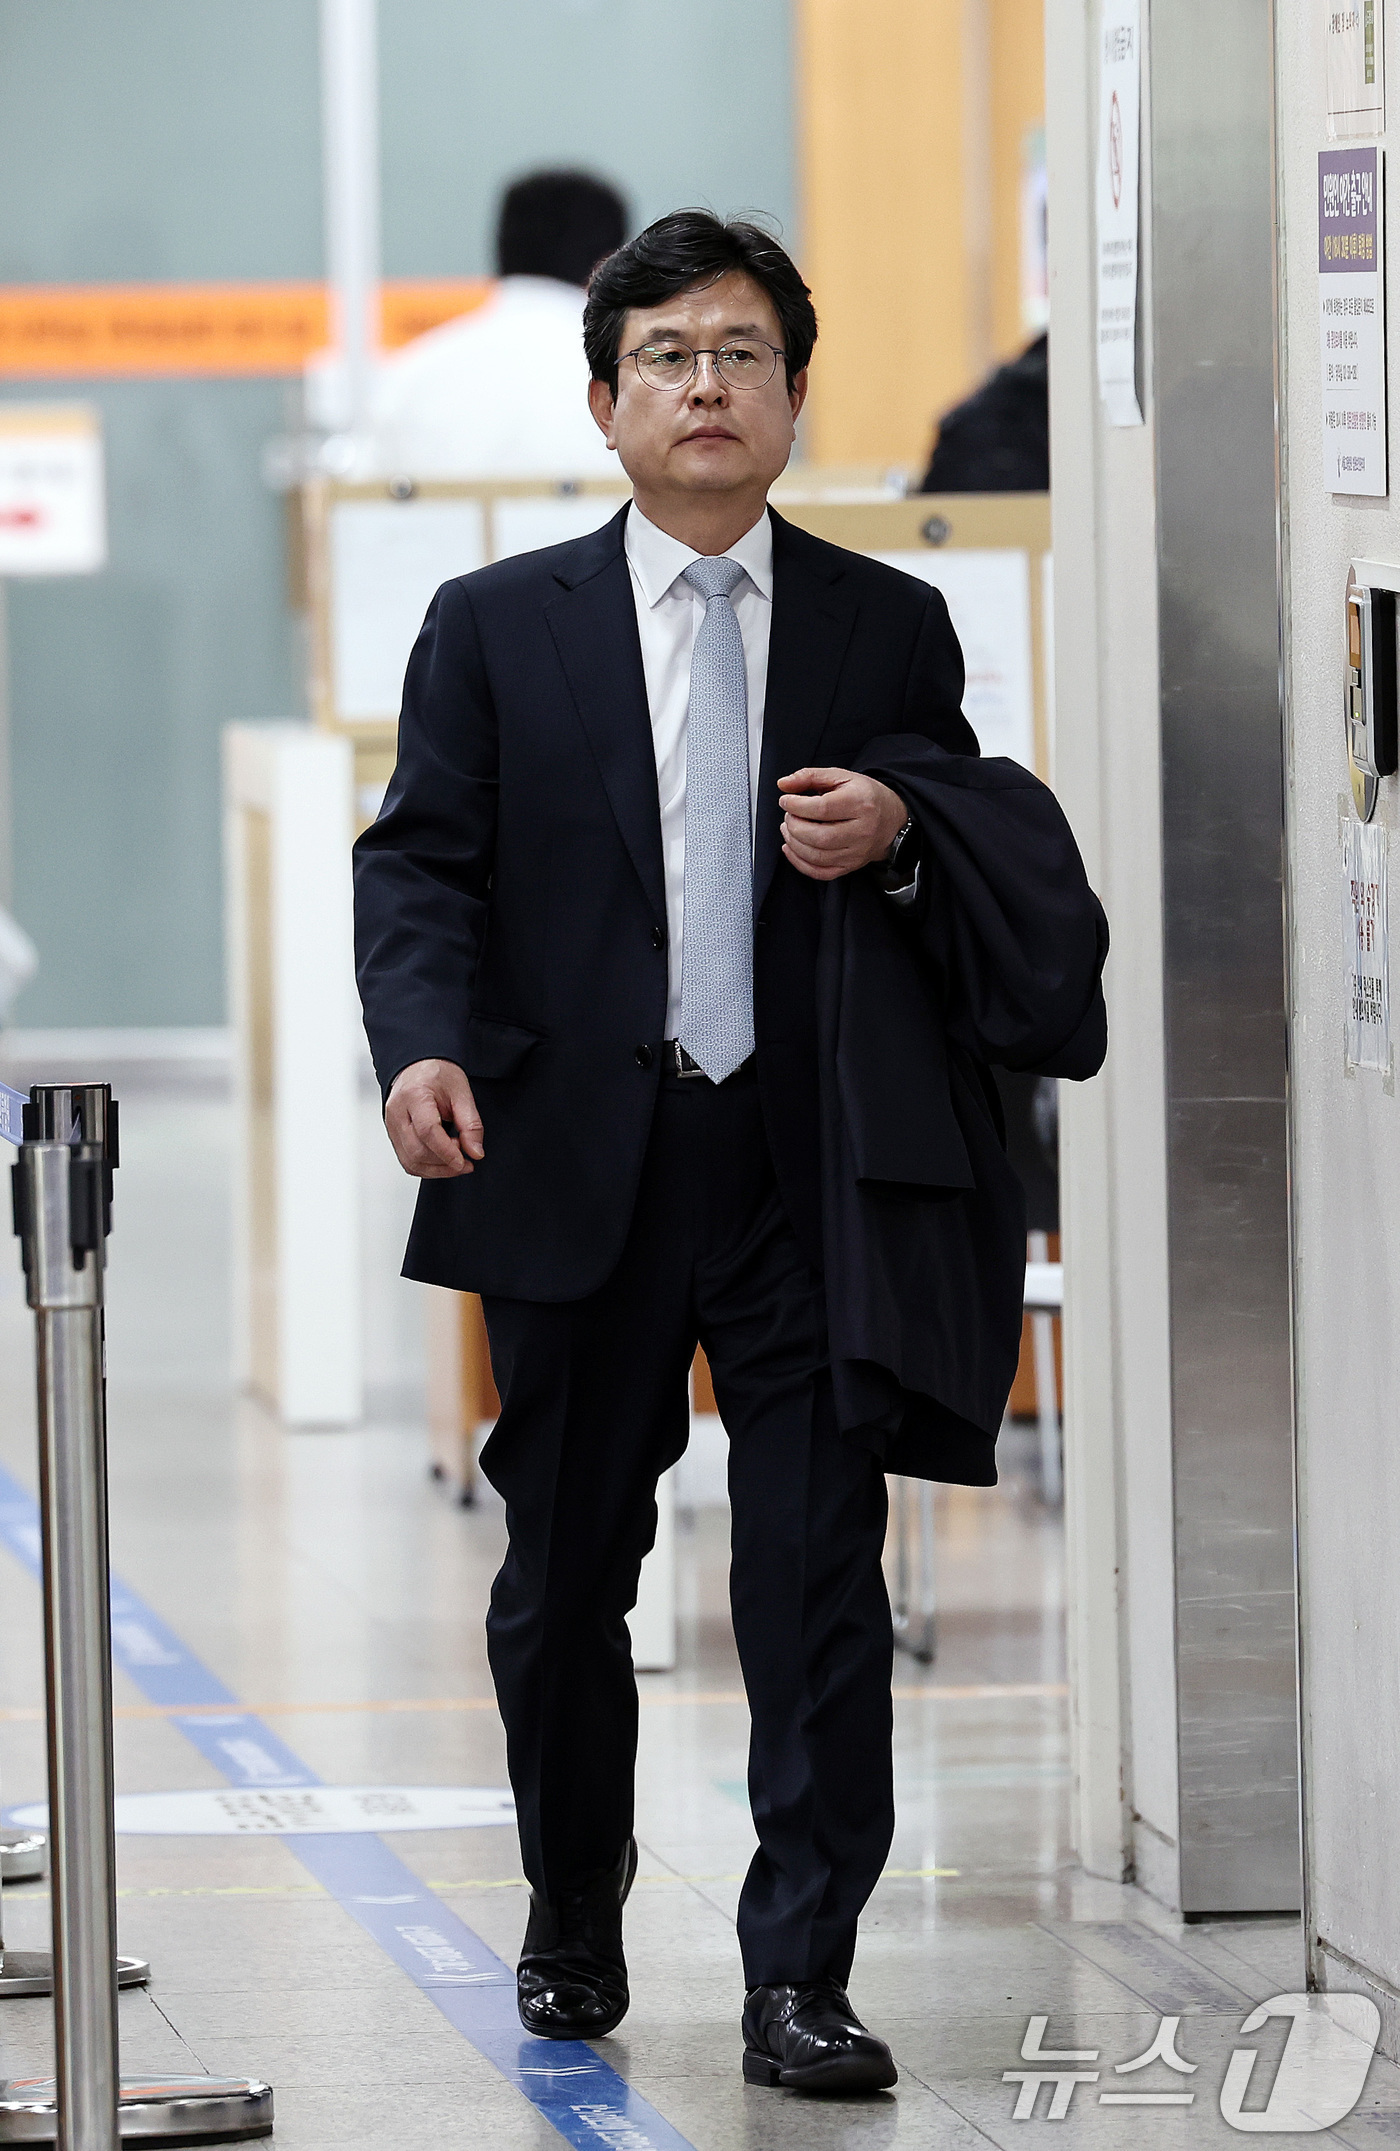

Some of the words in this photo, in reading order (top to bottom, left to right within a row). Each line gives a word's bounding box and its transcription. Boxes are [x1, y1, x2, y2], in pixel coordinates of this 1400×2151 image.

[1323, 172, 1339, 218] 민원인
[1340, 172, 1350, 217] 야간
[1351, 169, 1361, 217] 출구
[1362, 171, 1373, 216] 안내
